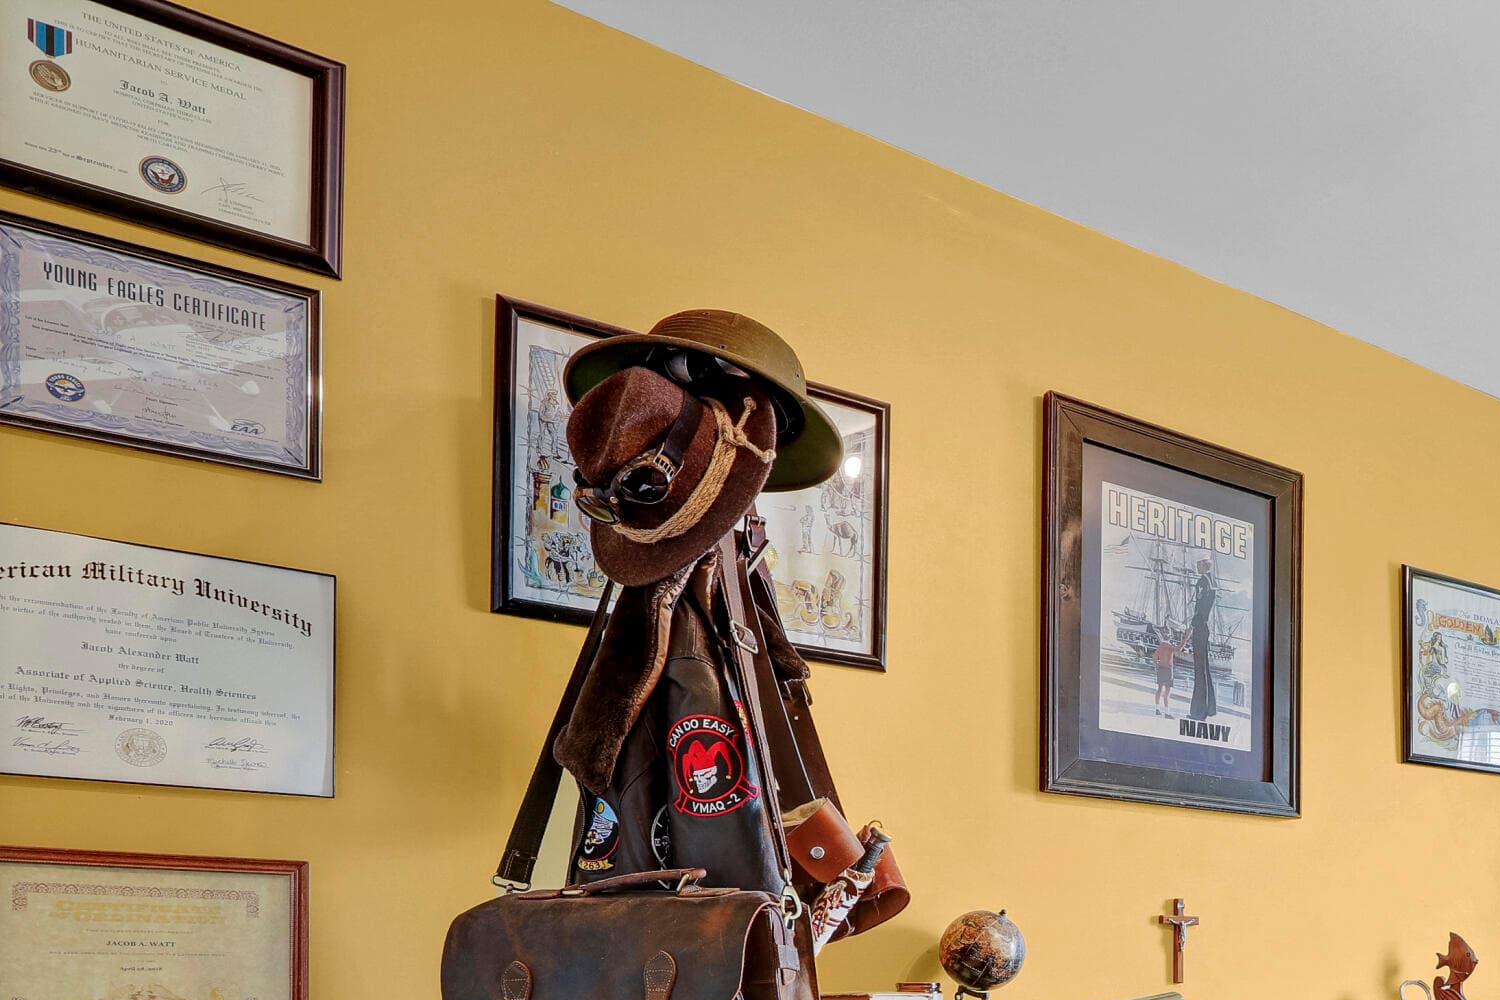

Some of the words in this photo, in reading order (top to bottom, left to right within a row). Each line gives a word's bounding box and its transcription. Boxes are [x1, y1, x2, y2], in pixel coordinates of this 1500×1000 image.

[82, 11, 101, 24] THE
[104, 20, 143, 38] UNITED
[144, 32, 182, 54] STATES
[198, 51, 242, 72] AMERICA
[75, 38, 162, 72] HUMANITARIAN
[164, 67, 209, 88] SERVICE
[210, 82, 248, 101] MEDAL
[119, 79, 155, 98] Jacob
[178, 96, 207, 115] Watt
[42, 261, 97, 292] YOUNG
[107, 276, 165, 308] EAGLES
[173, 292, 267, 331] CERTIFICATE
[230, 424, 260, 435] EAA
[1108, 488, 1248, 560] HERITAGE
[81, 560, 185, 596] Military
[193, 578, 313, 637] University
[1438, 615, 1481, 633] GOLDEN
[117, 645, 170, 661] Alexander
[669, 725, 684, 748] CAN
[683, 719, 699, 731] DO
[702, 719, 735, 737] EASY
[1178, 718, 1232, 744] NAVY
